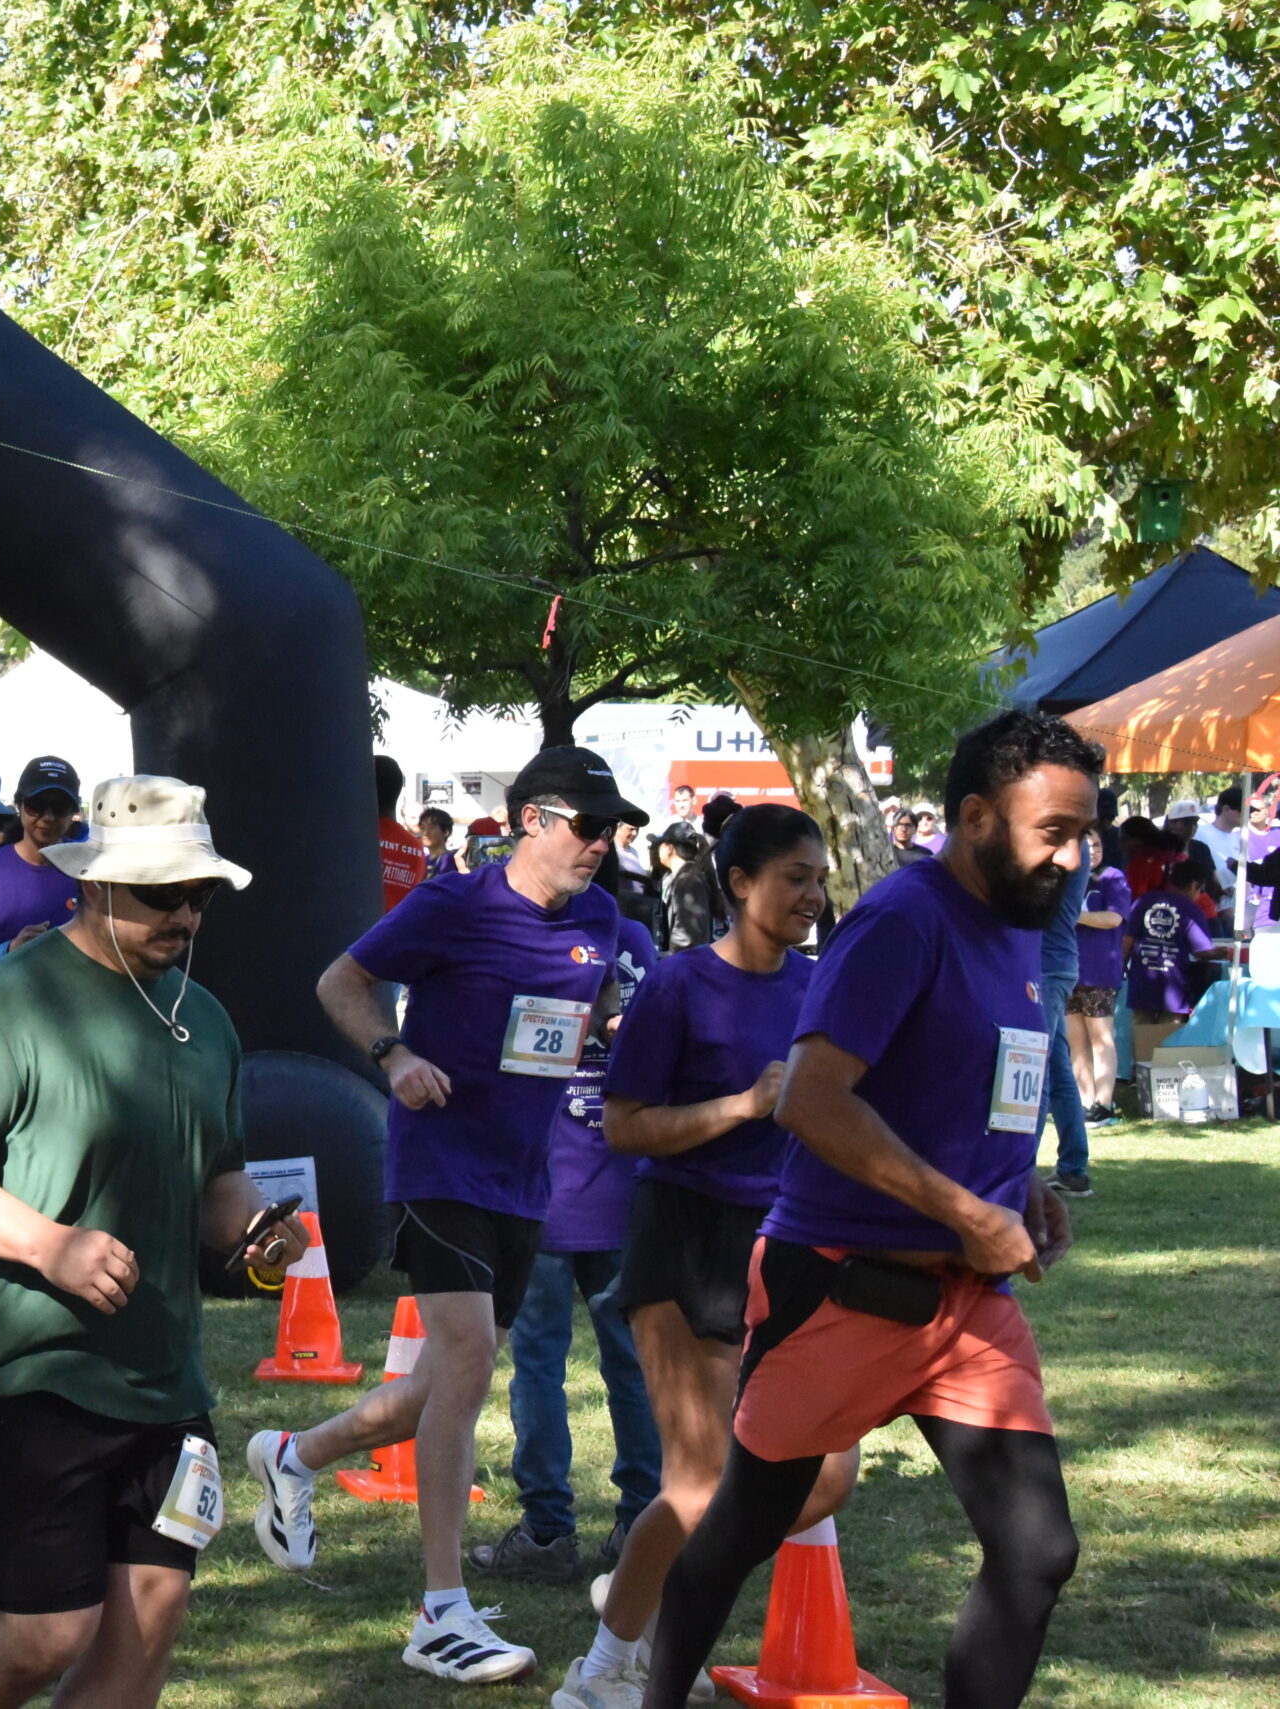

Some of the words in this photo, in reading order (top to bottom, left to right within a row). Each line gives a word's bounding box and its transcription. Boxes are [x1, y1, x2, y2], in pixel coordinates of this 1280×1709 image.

[697, 731, 772, 753] U-HA
[380, 840, 399, 851] VENT
[533, 1028, 564, 1054] 28
[1013, 1069, 1040, 1102] 104
[196, 1485, 218, 1523] 52
